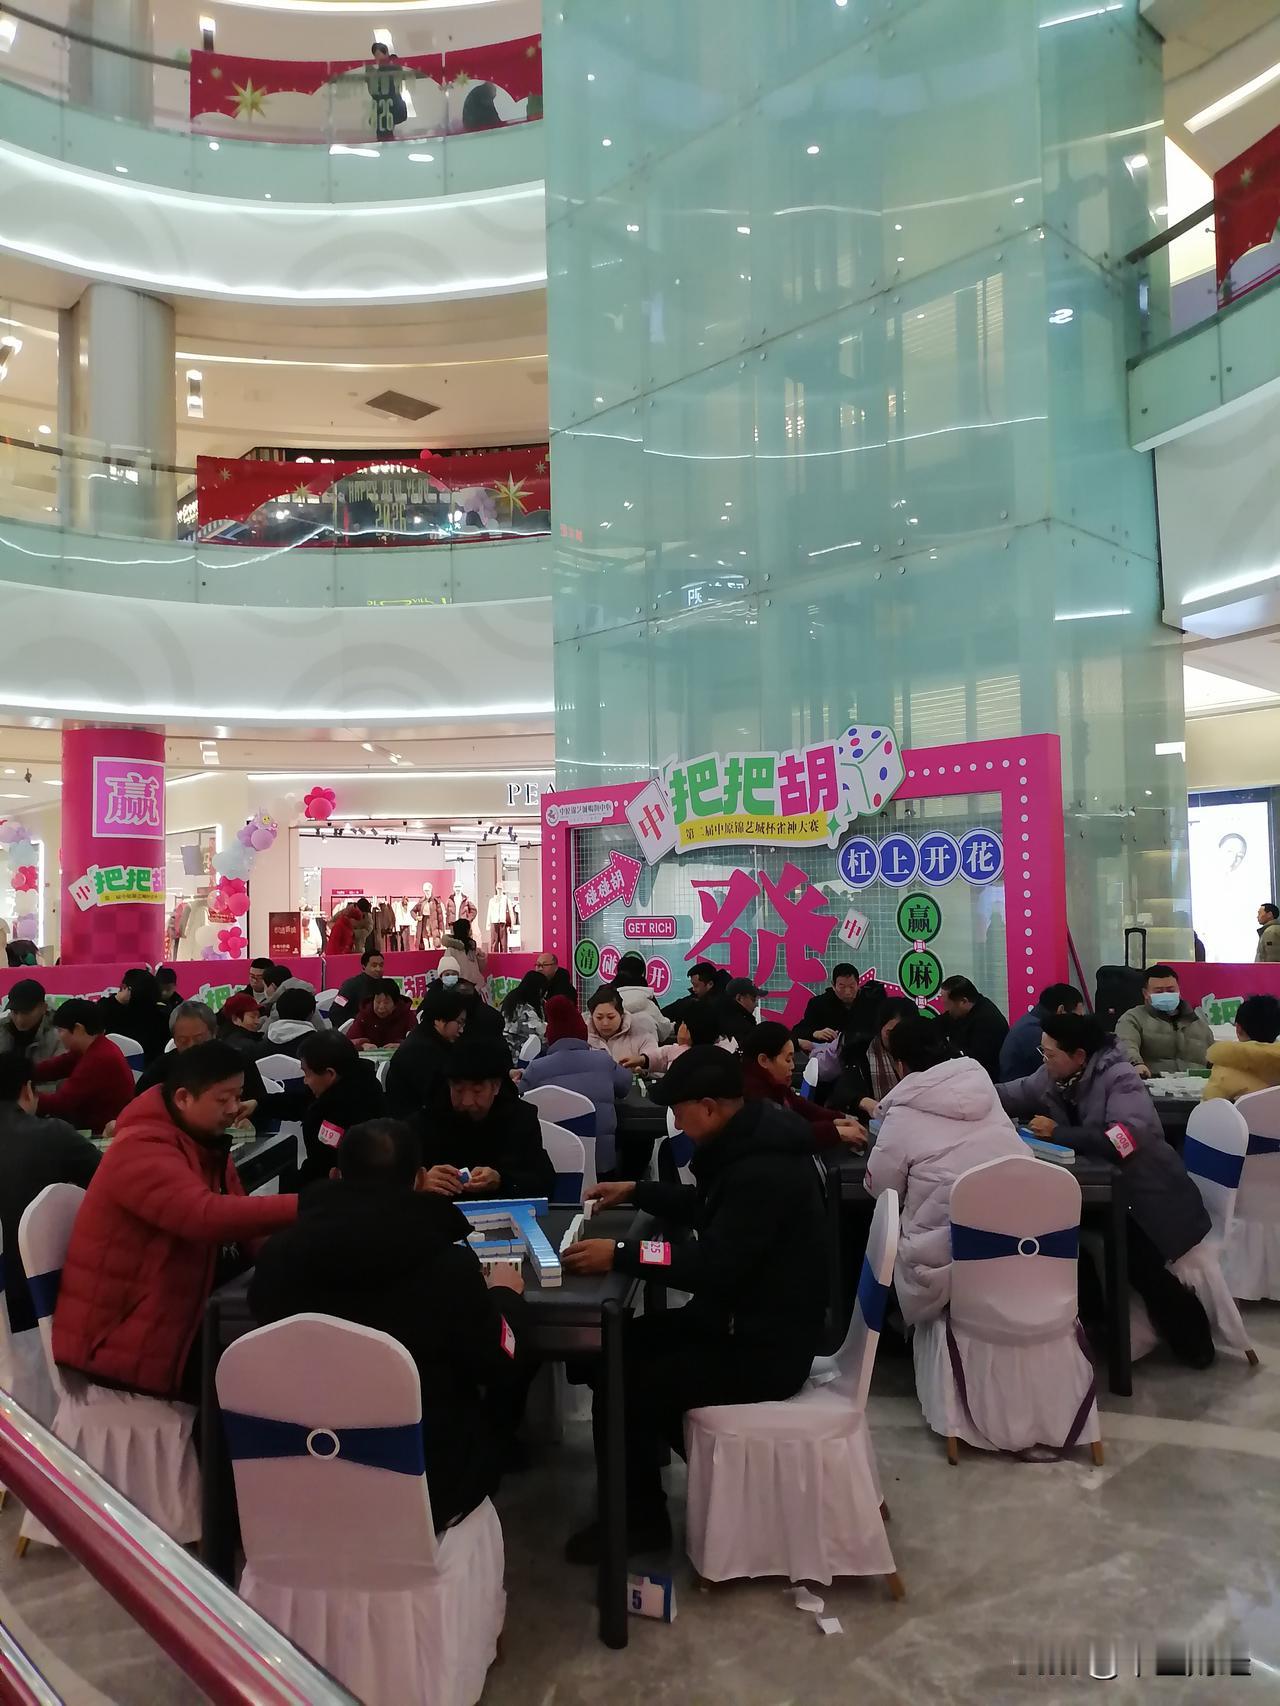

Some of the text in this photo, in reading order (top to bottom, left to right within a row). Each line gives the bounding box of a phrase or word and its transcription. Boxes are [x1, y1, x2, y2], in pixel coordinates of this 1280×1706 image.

[104, 772, 160, 825] 赢
[669, 745, 839, 826] 把把胡
[638, 803, 665, 841] 中
[847, 841, 995, 878] 杠上开花
[628, 922, 672, 934] GET RICH
[844, 919, 862, 939] 中
[632, 1589, 643, 1610] 5
